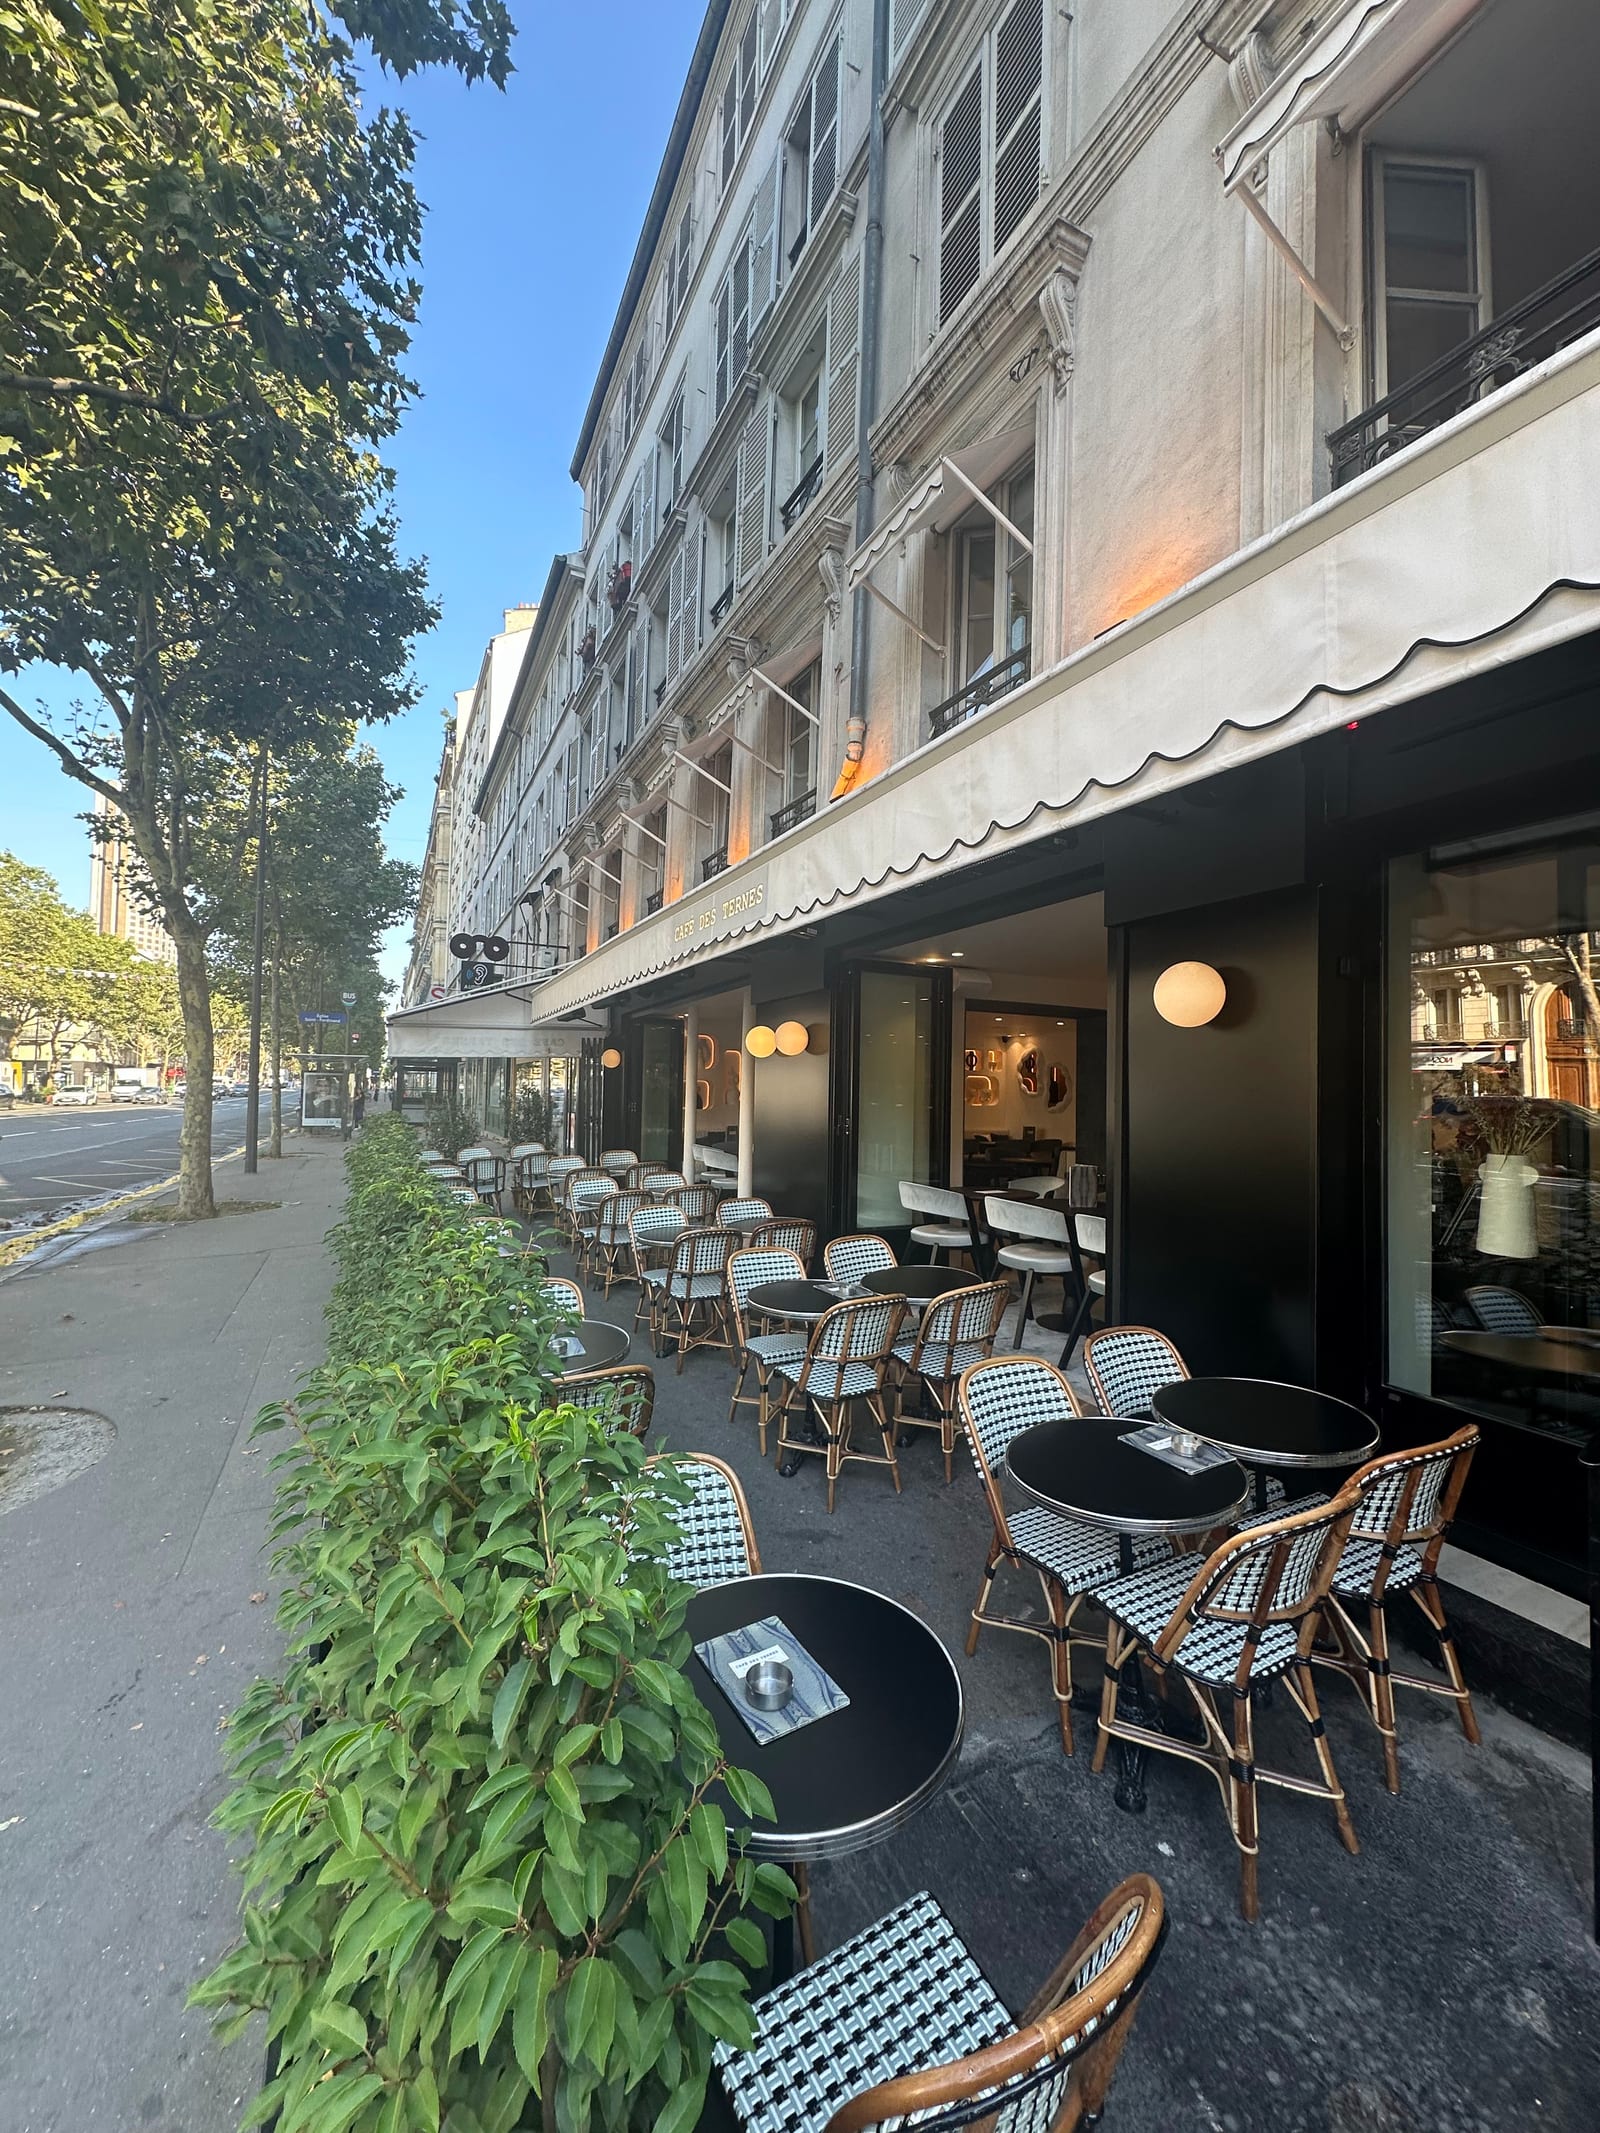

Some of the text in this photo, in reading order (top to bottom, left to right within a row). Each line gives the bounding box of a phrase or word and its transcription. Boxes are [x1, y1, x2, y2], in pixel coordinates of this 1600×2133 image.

[674, 883, 764, 942] CAFÉ DES TERNES
